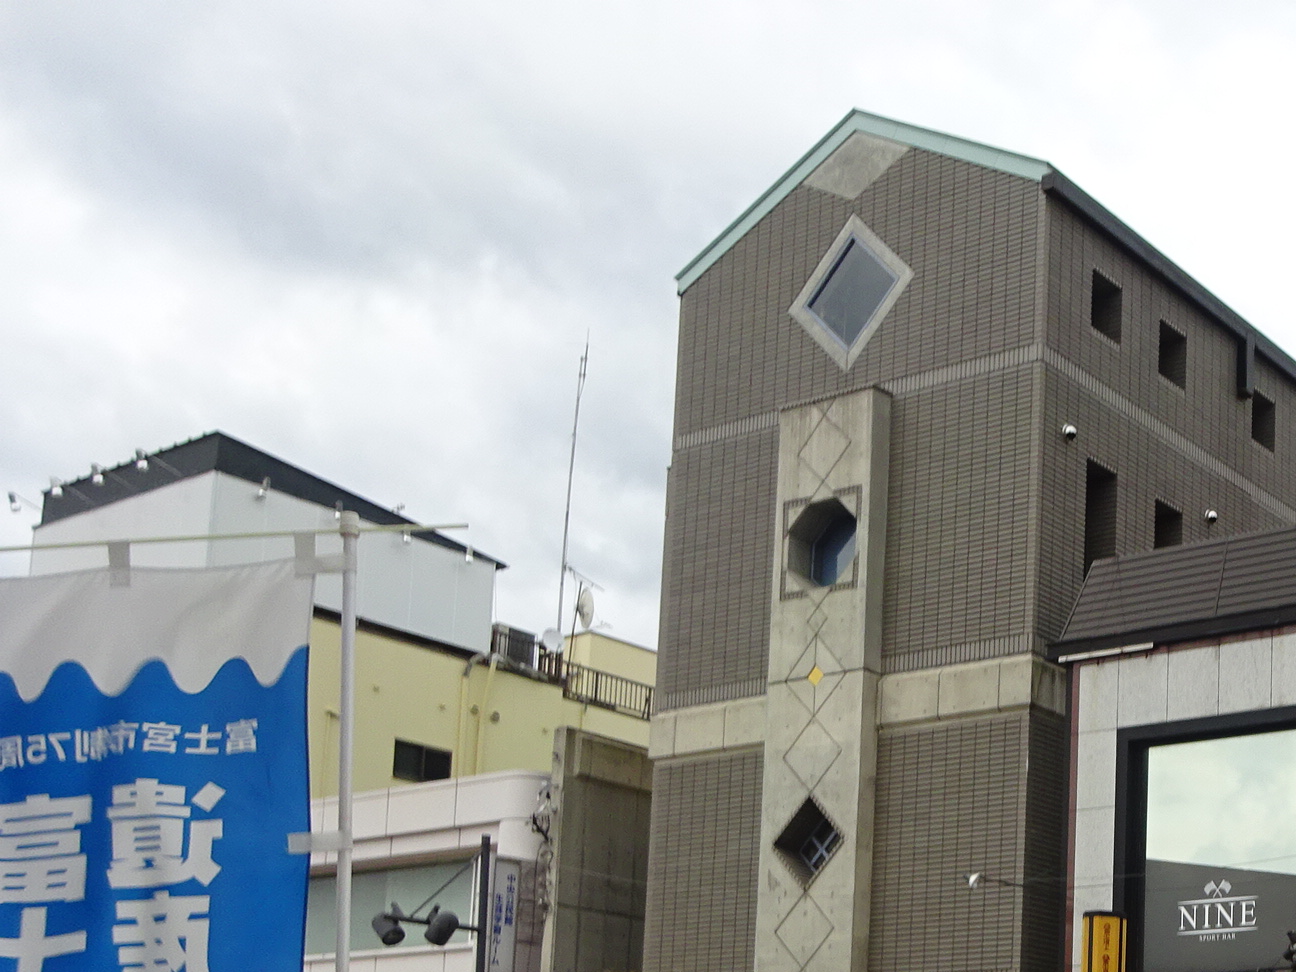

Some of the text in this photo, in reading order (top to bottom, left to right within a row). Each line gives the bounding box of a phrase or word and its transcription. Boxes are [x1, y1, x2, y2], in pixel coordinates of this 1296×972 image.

[1178, 900, 1257, 931] NINE
[1199, 932, 1237, 942] SPORT BAR
